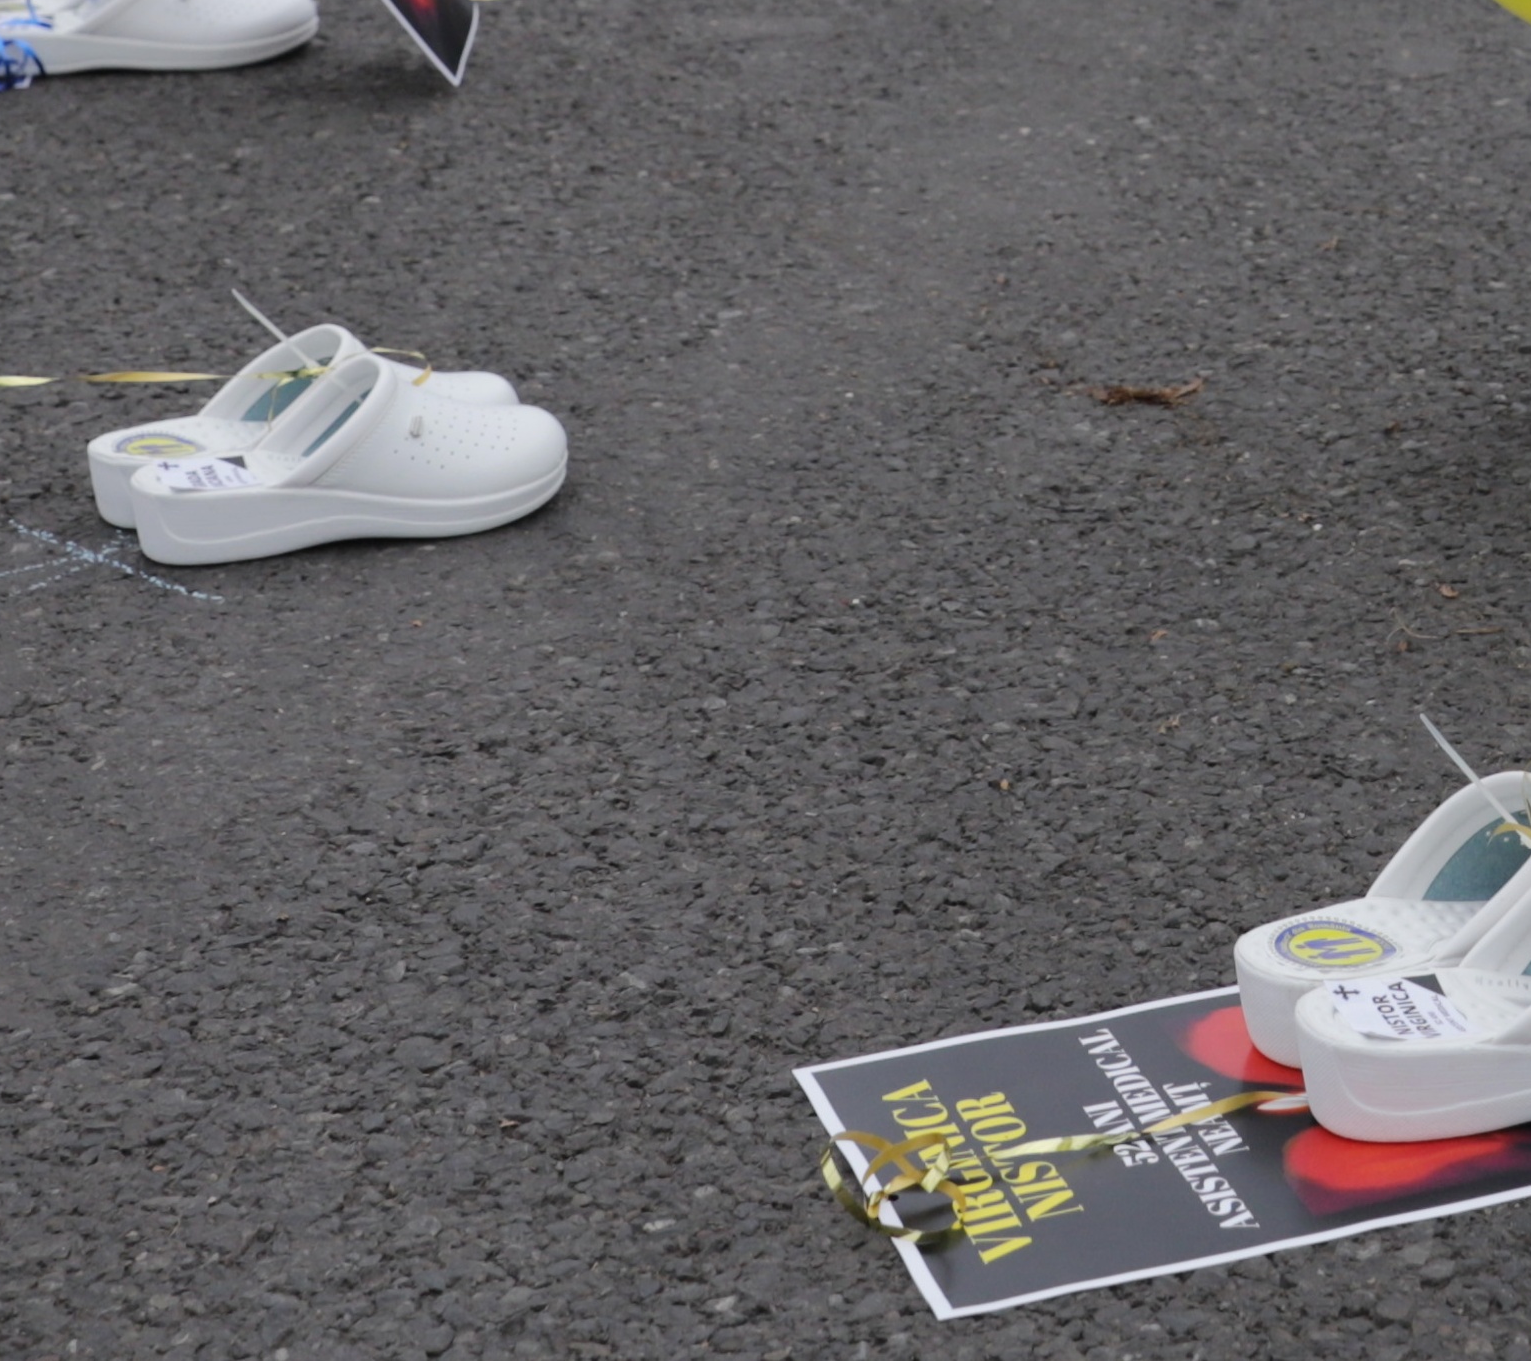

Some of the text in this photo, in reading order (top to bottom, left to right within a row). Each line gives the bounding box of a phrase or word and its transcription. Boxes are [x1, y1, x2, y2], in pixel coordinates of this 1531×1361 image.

[1372, 993, 1415, 1036] NISTOR
[1078, 1027, 1175, 1126] MEDICAL
[955, 1091, 1084, 1221] NISTOR
[1082, 1099, 1160, 1168] 52 ANI
